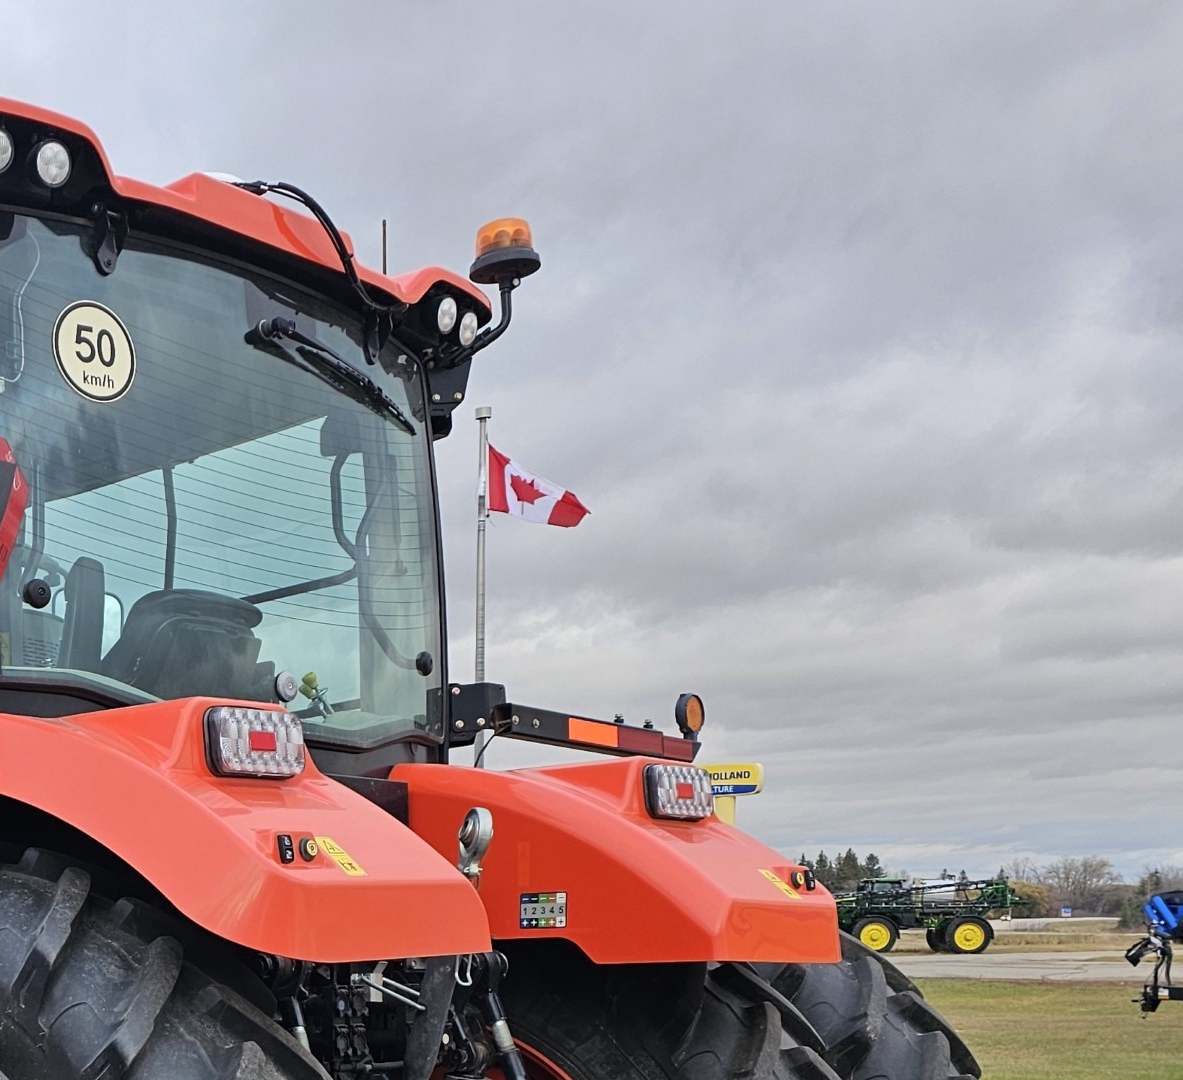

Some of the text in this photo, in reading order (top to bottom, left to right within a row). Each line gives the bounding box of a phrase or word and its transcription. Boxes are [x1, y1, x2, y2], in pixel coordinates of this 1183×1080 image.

[75, 323, 116, 368] 50
[82, 370, 115, 389] km/h
[531, 907, 537, 915] 2
[540, 906, 546, 915] 3
[549, 906, 555, 914] 4
[558, 906, 564, 914] 5
